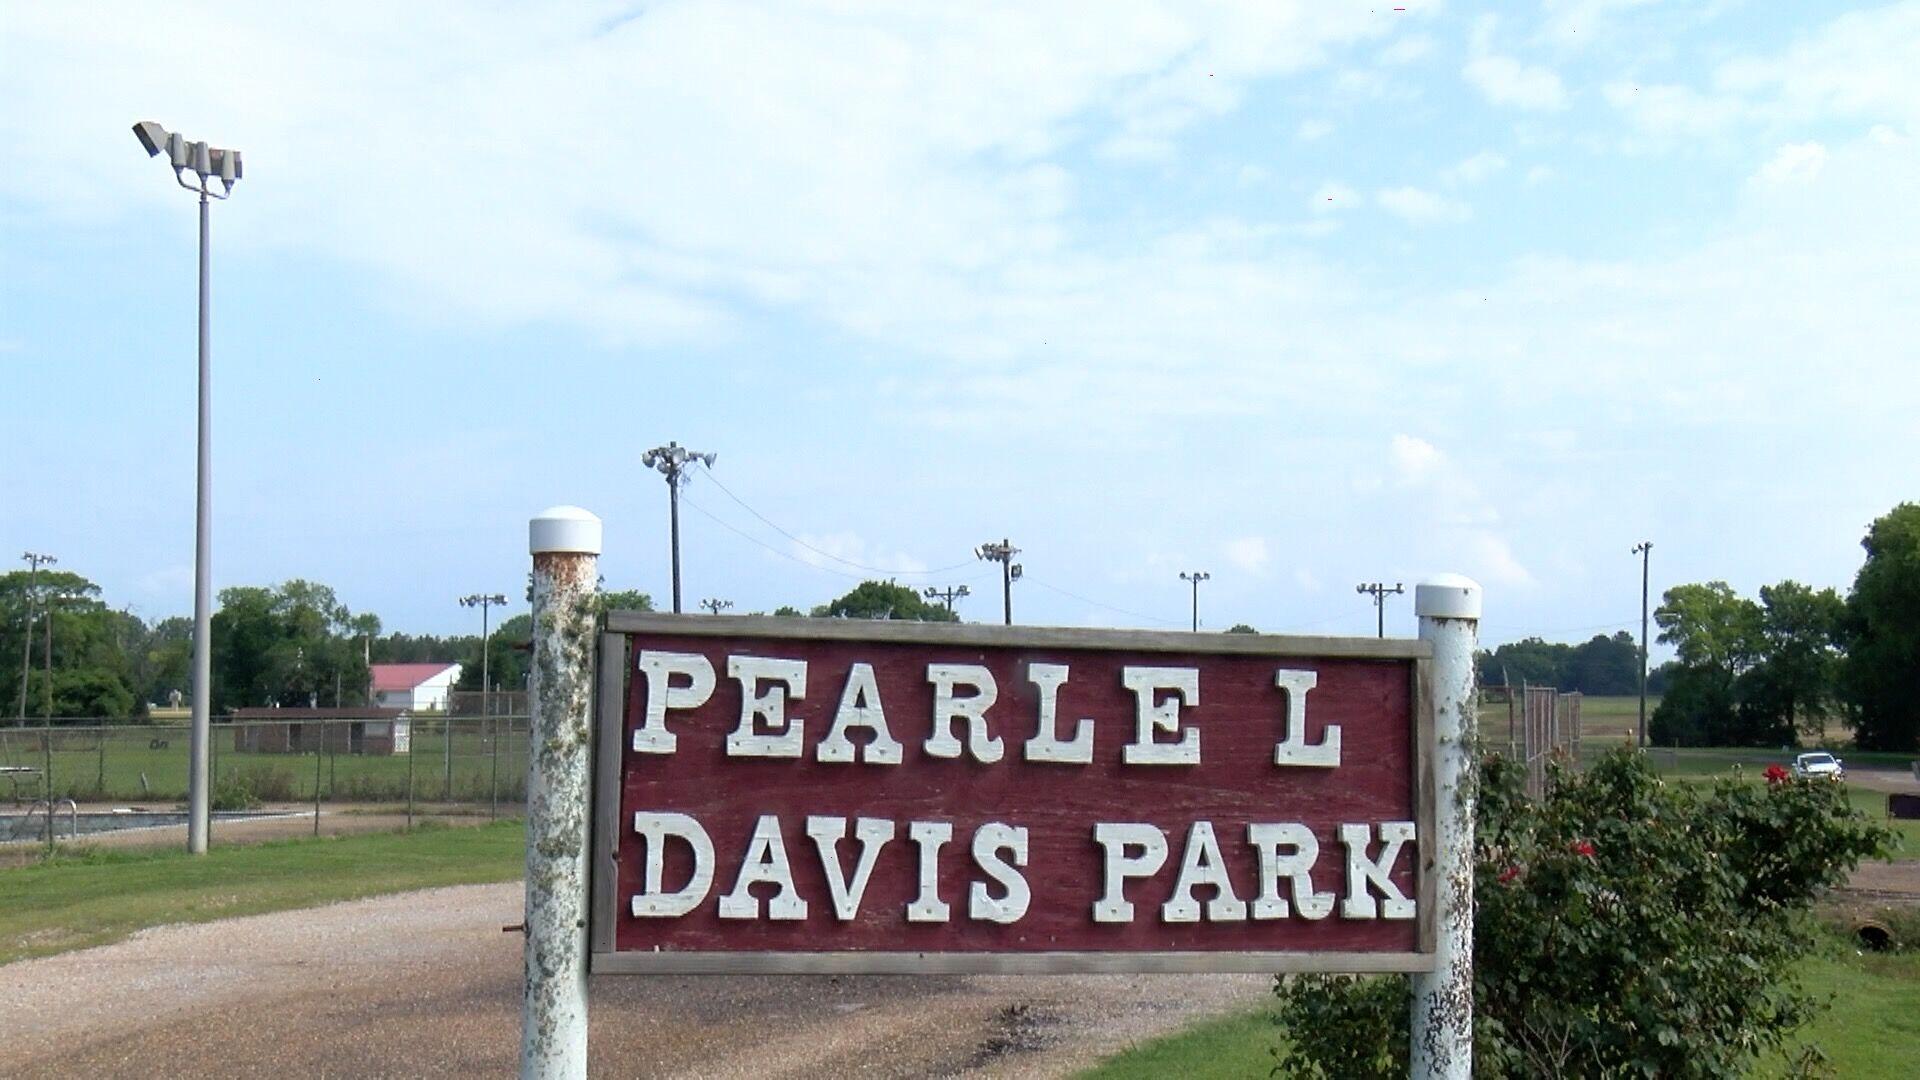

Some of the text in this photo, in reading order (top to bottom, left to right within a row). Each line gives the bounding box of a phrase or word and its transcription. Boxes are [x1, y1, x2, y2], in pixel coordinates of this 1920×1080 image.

[632, 649, 1343, 768] PEARLE L
[630, 810, 1418, 925] DAVIS PARK
